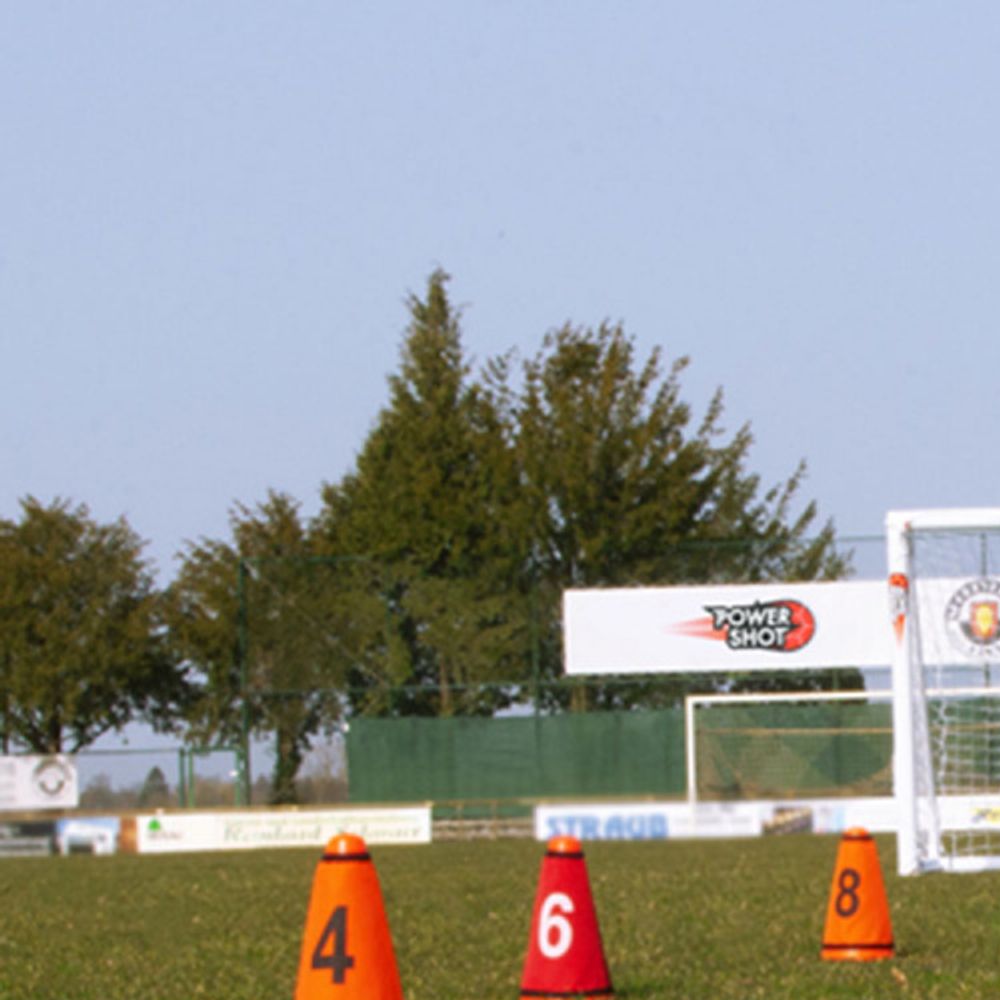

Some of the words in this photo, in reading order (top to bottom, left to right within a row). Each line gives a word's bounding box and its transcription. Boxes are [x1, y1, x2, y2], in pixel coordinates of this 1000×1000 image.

[713, 607, 791, 627] POWER
[730, 627, 786, 647] SHOT
[834, 868, 861, 918] 8
[311, 905, 355, 985] 4
[537, 892, 575, 959] 6
